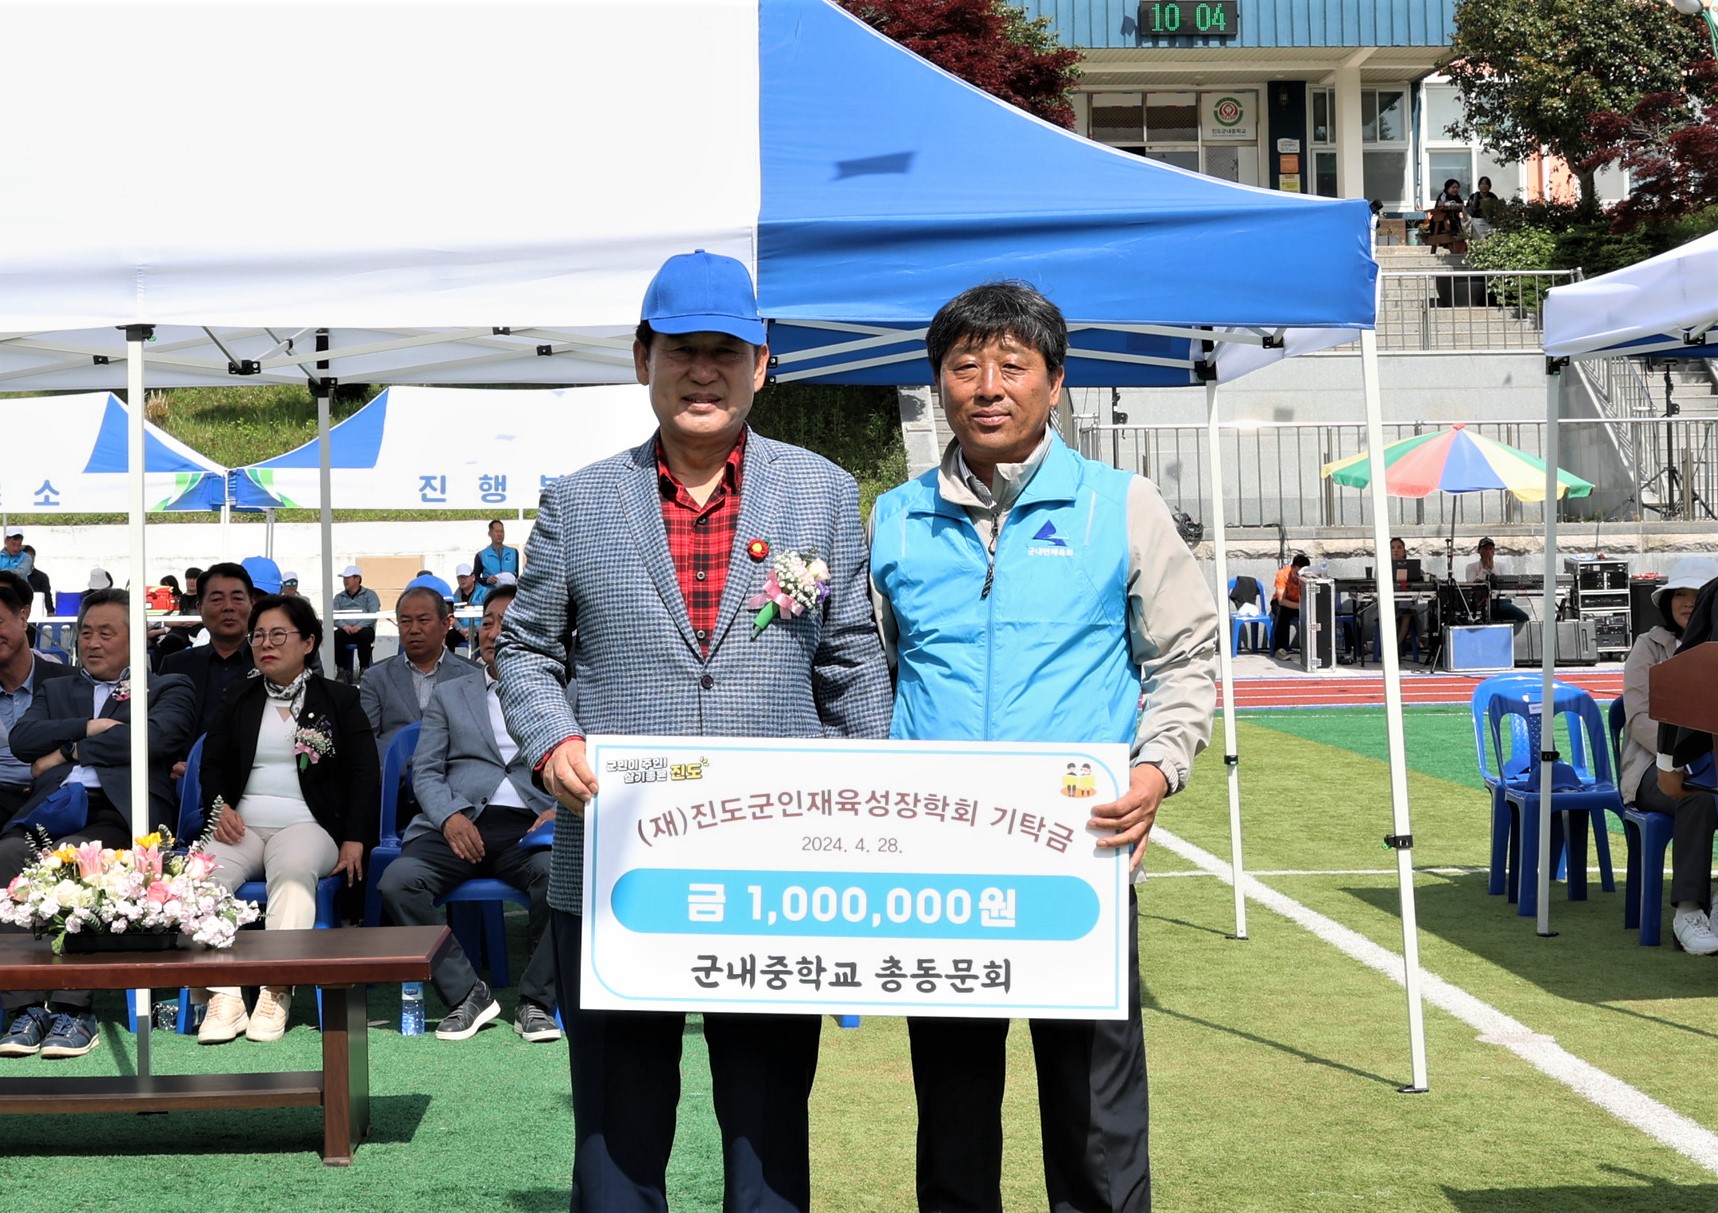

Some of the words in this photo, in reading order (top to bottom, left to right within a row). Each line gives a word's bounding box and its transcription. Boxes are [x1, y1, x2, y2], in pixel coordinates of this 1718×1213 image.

[1152, 3, 1179, 31] 10
[1196, 3, 1226, 31] 04
[606, 759, 640, 772] 군민이
[670, 763, 703, 780] 진도
[990, 806, 1075, 854] 기탁금
[802, 836, 847, 852] 2024.
[855, 838, 870, 853] 4.
[878, 838, 903, 854] 28.
[687, 882, 727, 922] 금
[747, 884, 1017, 928] 1,000,000원
[690, 953, 863, 991] 군내중학교
[874, 954, 1012, 994] 총동문회
